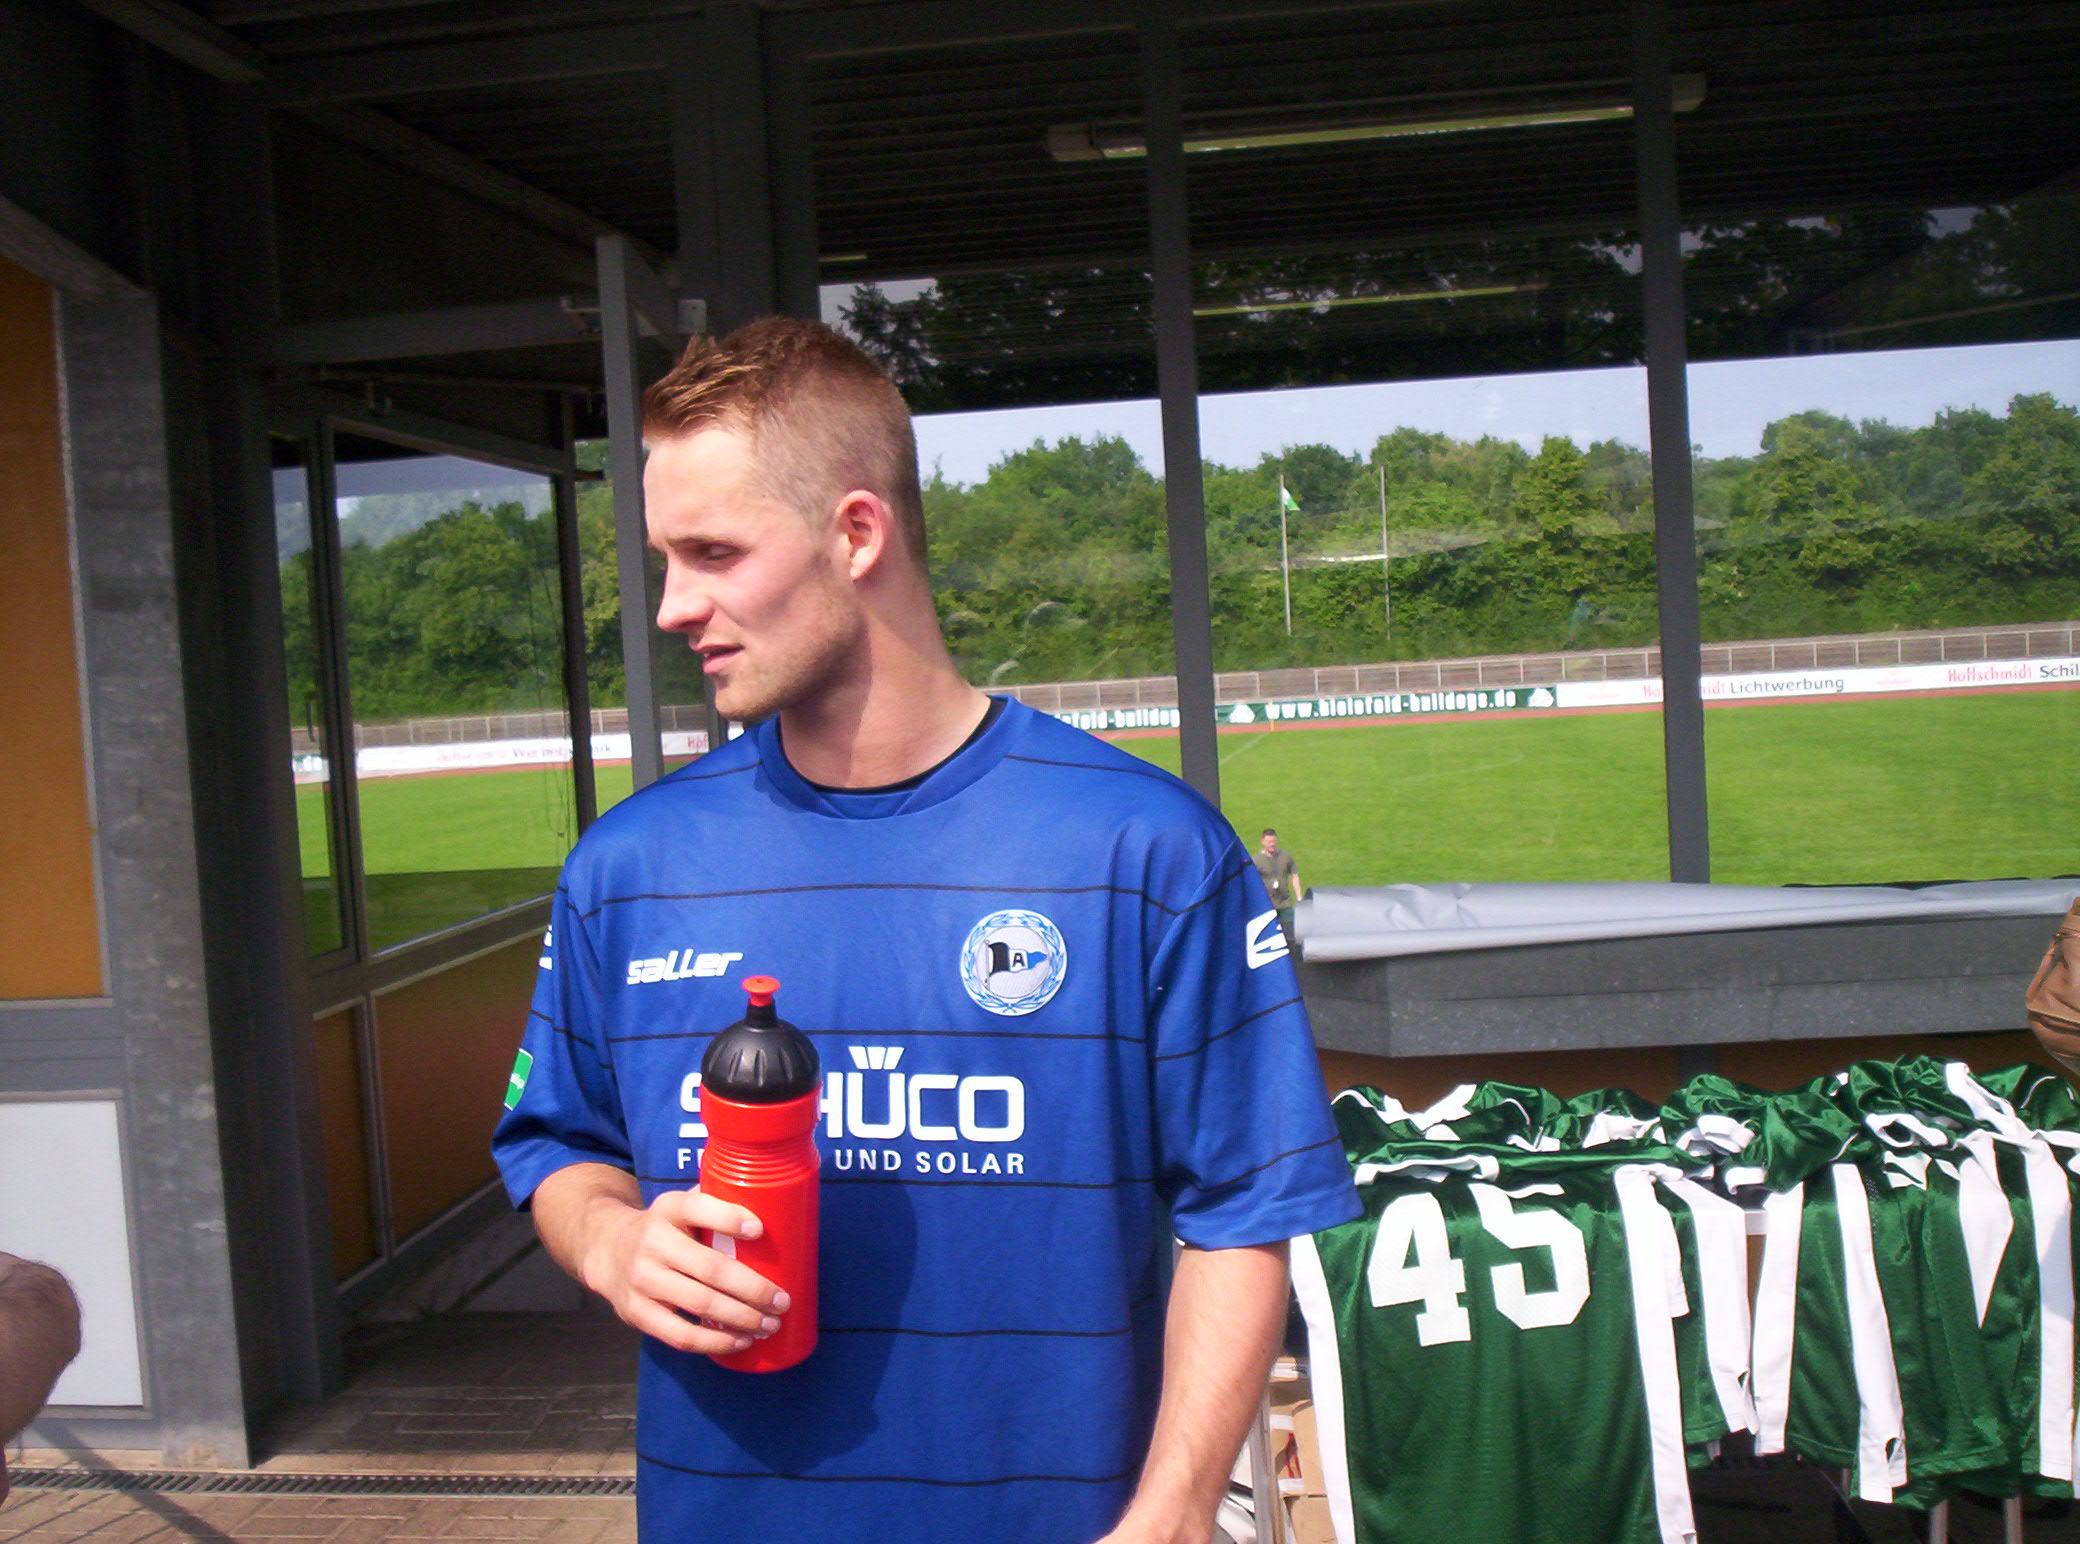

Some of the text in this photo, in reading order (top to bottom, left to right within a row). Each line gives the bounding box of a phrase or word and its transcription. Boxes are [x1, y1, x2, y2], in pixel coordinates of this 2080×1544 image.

[1730, 677, 1845, 694] Lichtwerbung
[626, 949, 744, 985] saller
[1012, 951, 1026, 968] A
[835, 1149, 1026, 1176] UND SOLAR
[1367, 1182, 1591, 1348] 45
